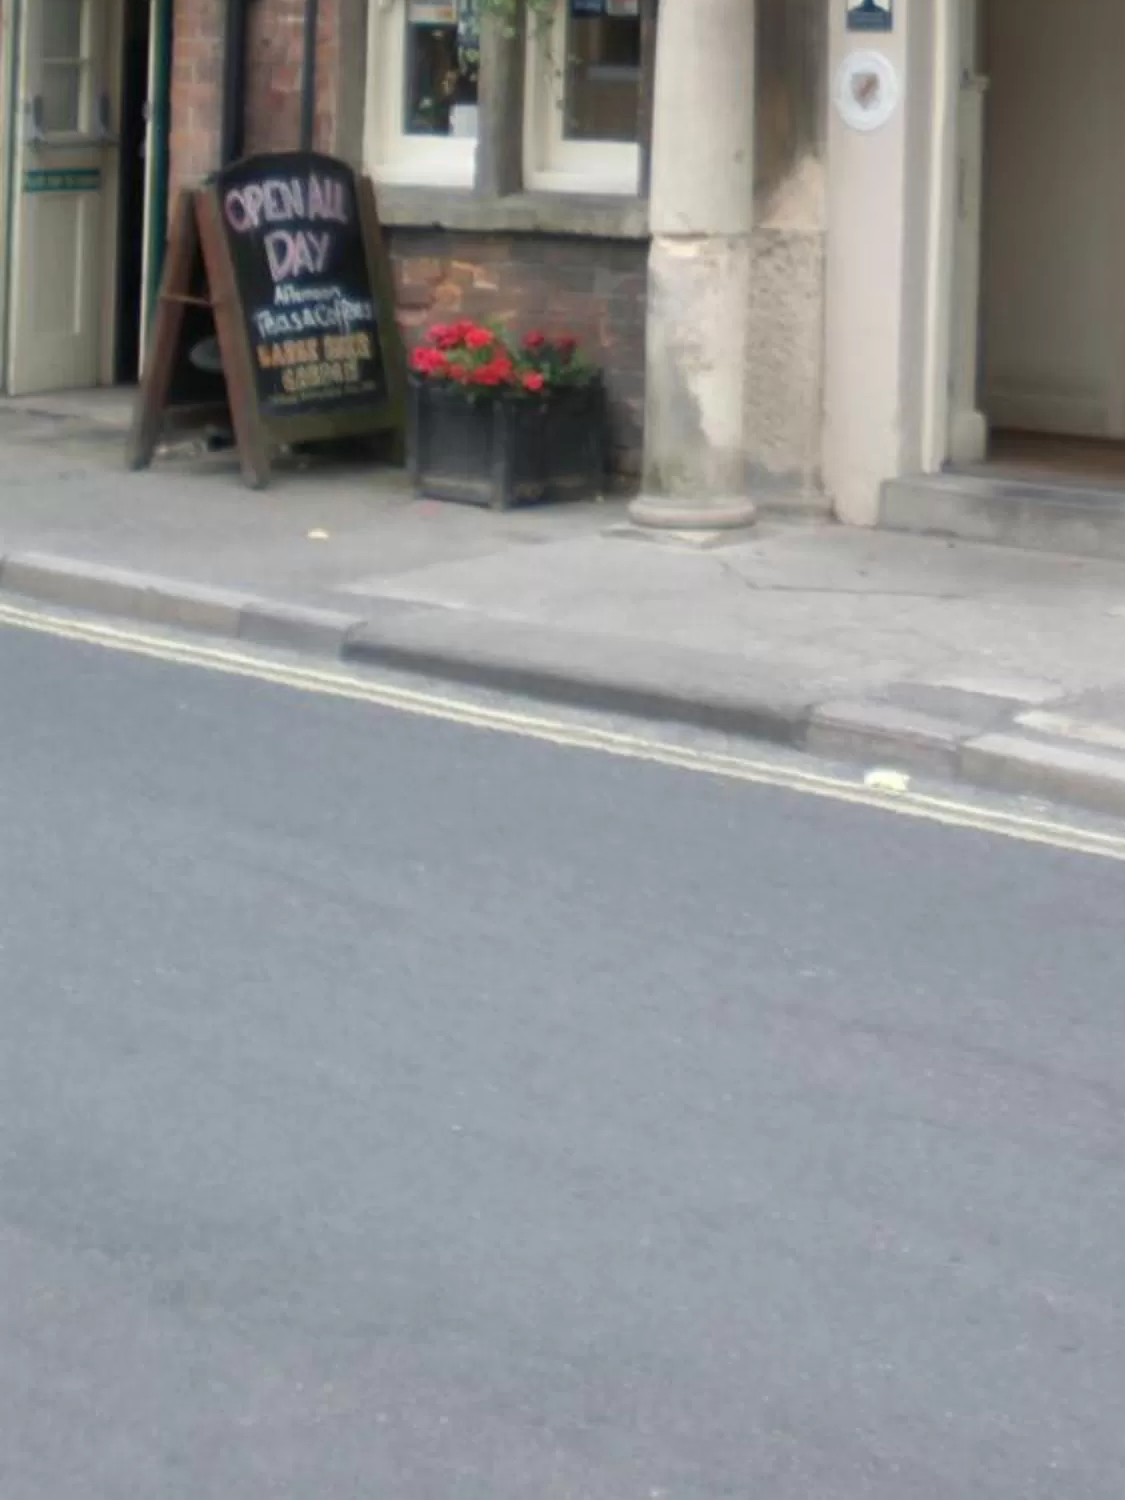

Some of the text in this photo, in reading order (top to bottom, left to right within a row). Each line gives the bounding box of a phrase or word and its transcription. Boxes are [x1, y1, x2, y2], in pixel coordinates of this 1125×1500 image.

[225, 171, 348, 233] OPEN ALL
[263, 229, 332, 283] DAY
